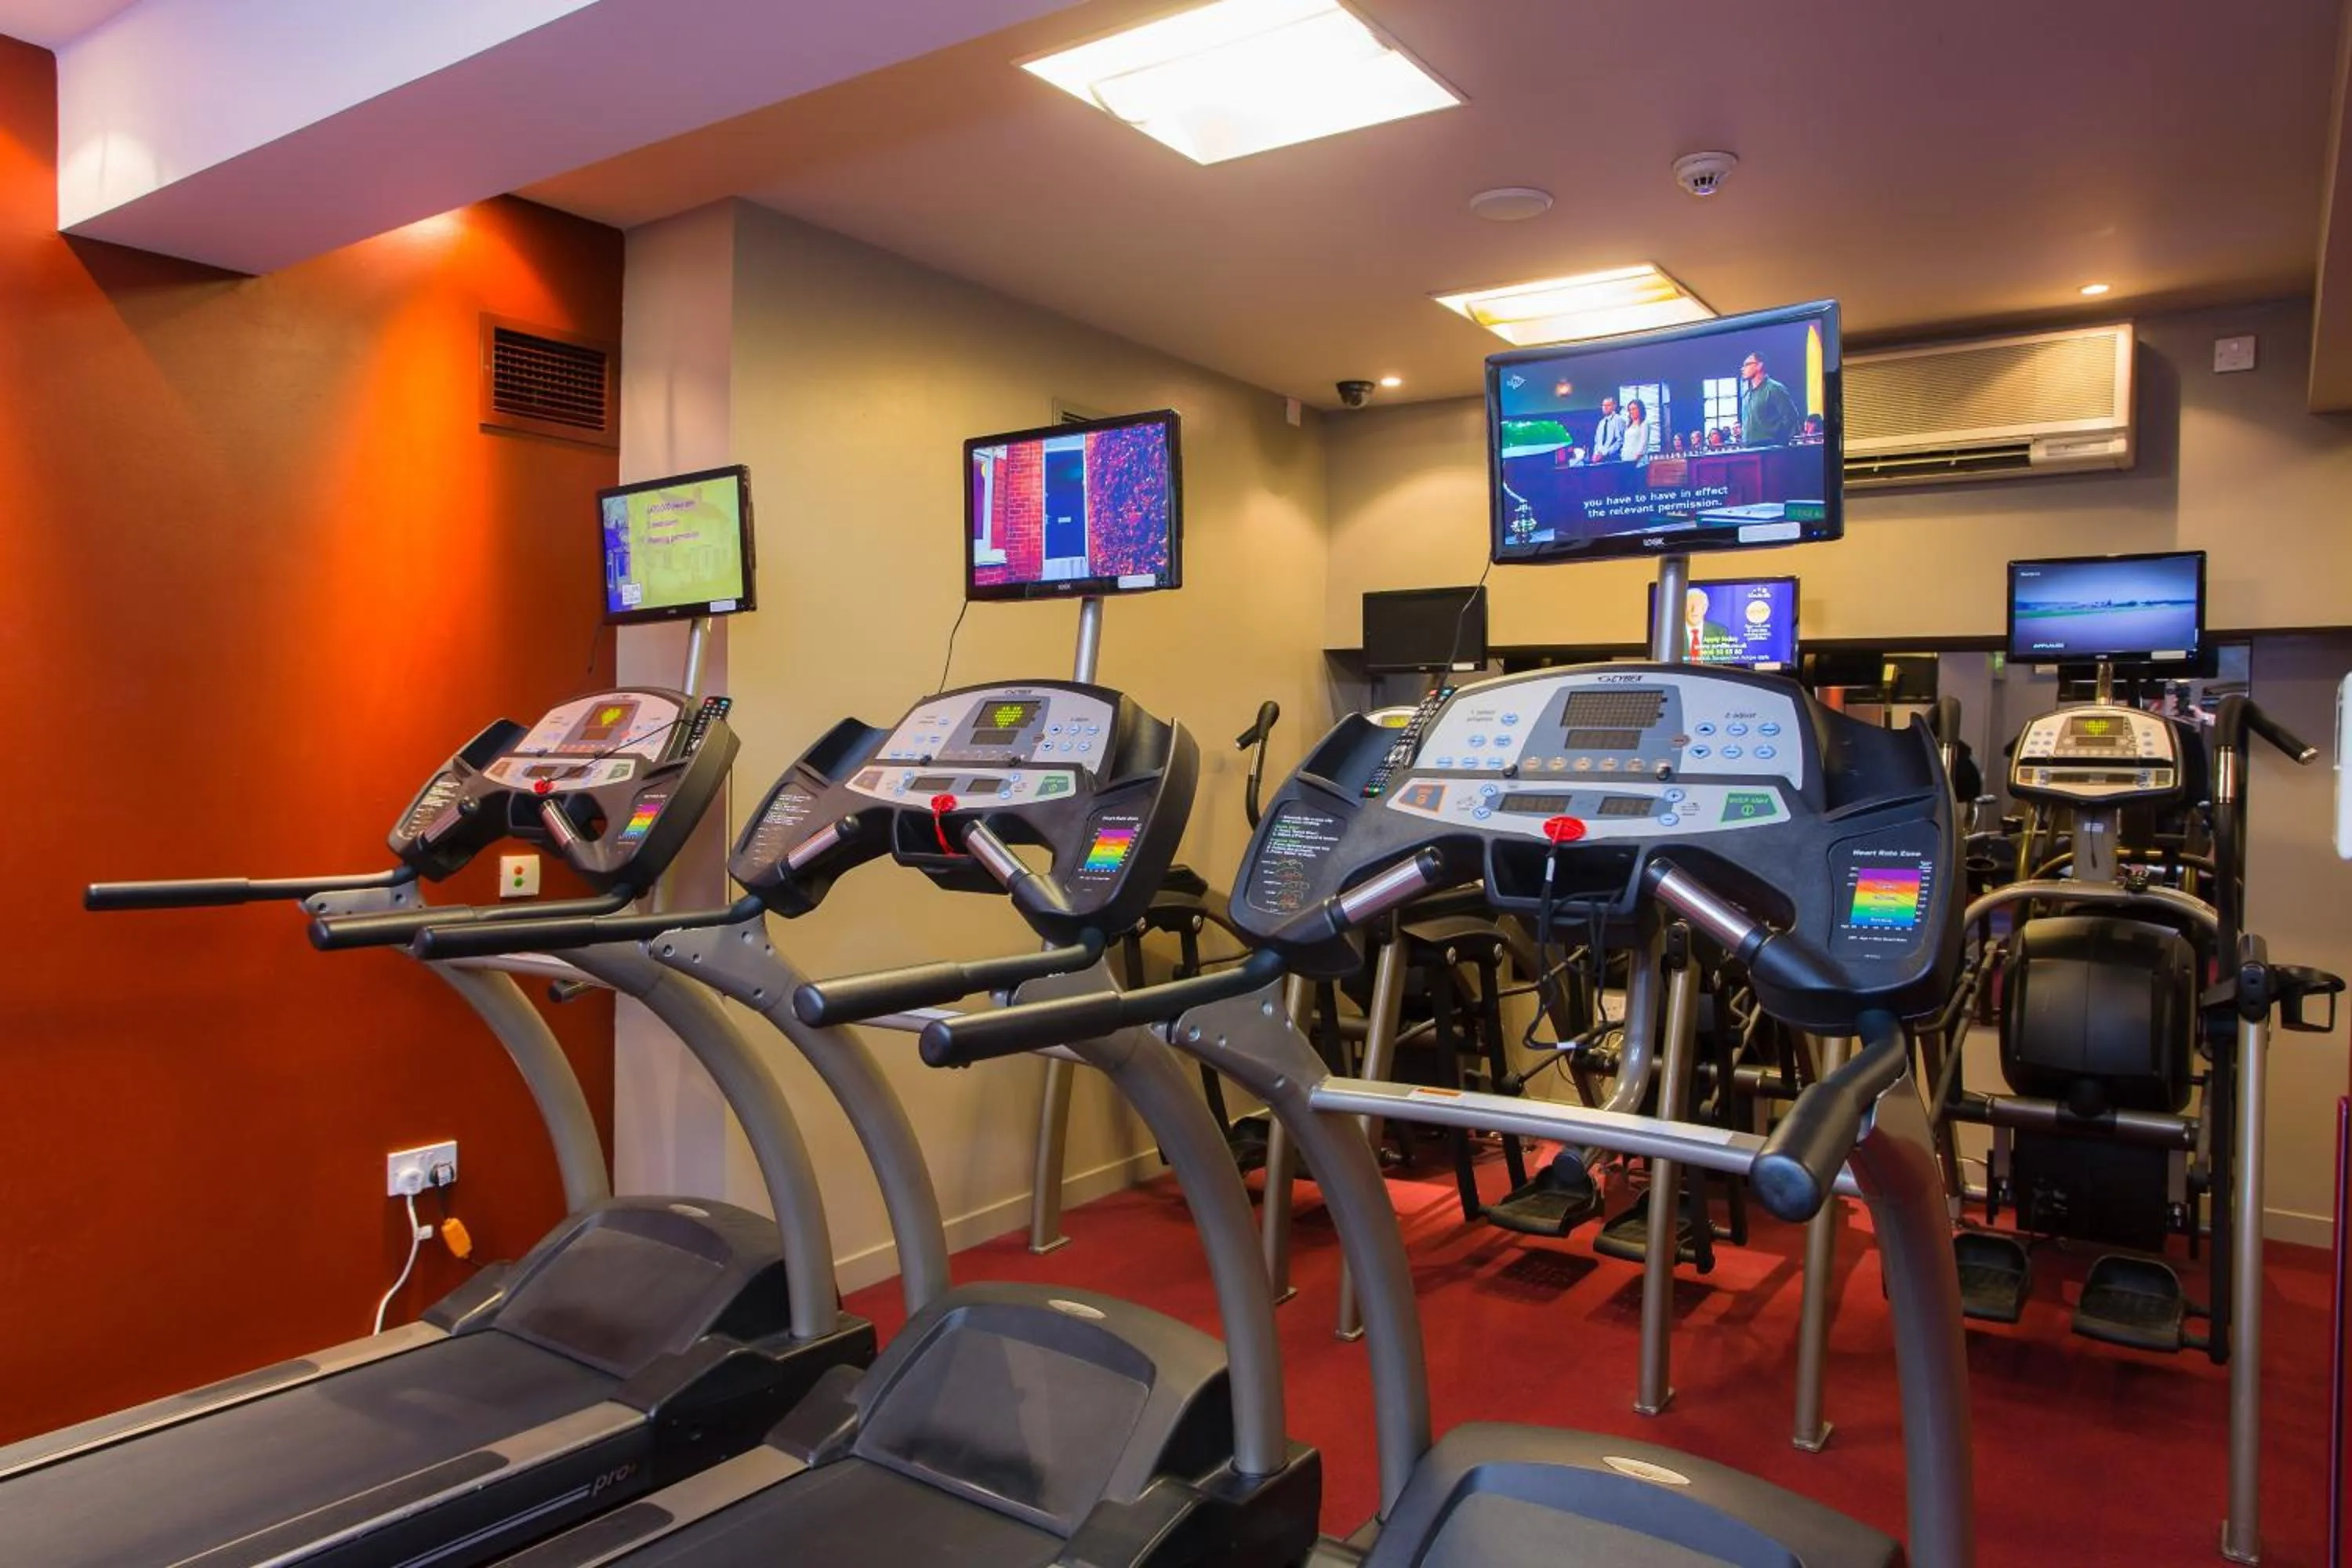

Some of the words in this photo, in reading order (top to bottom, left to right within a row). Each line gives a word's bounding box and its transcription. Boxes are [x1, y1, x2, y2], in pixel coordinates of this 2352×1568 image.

[1606, 496, 1632, 506] have
[1650, 492, 1677, 500] have
[1680, 489, 1691, 498] in
[1695, 486, 1729, 496] effect
[1588, 510, 1605, 518] the
[1610, 504, 1654, 515] relevant
[1658, 499, 1722, 514] permission.
